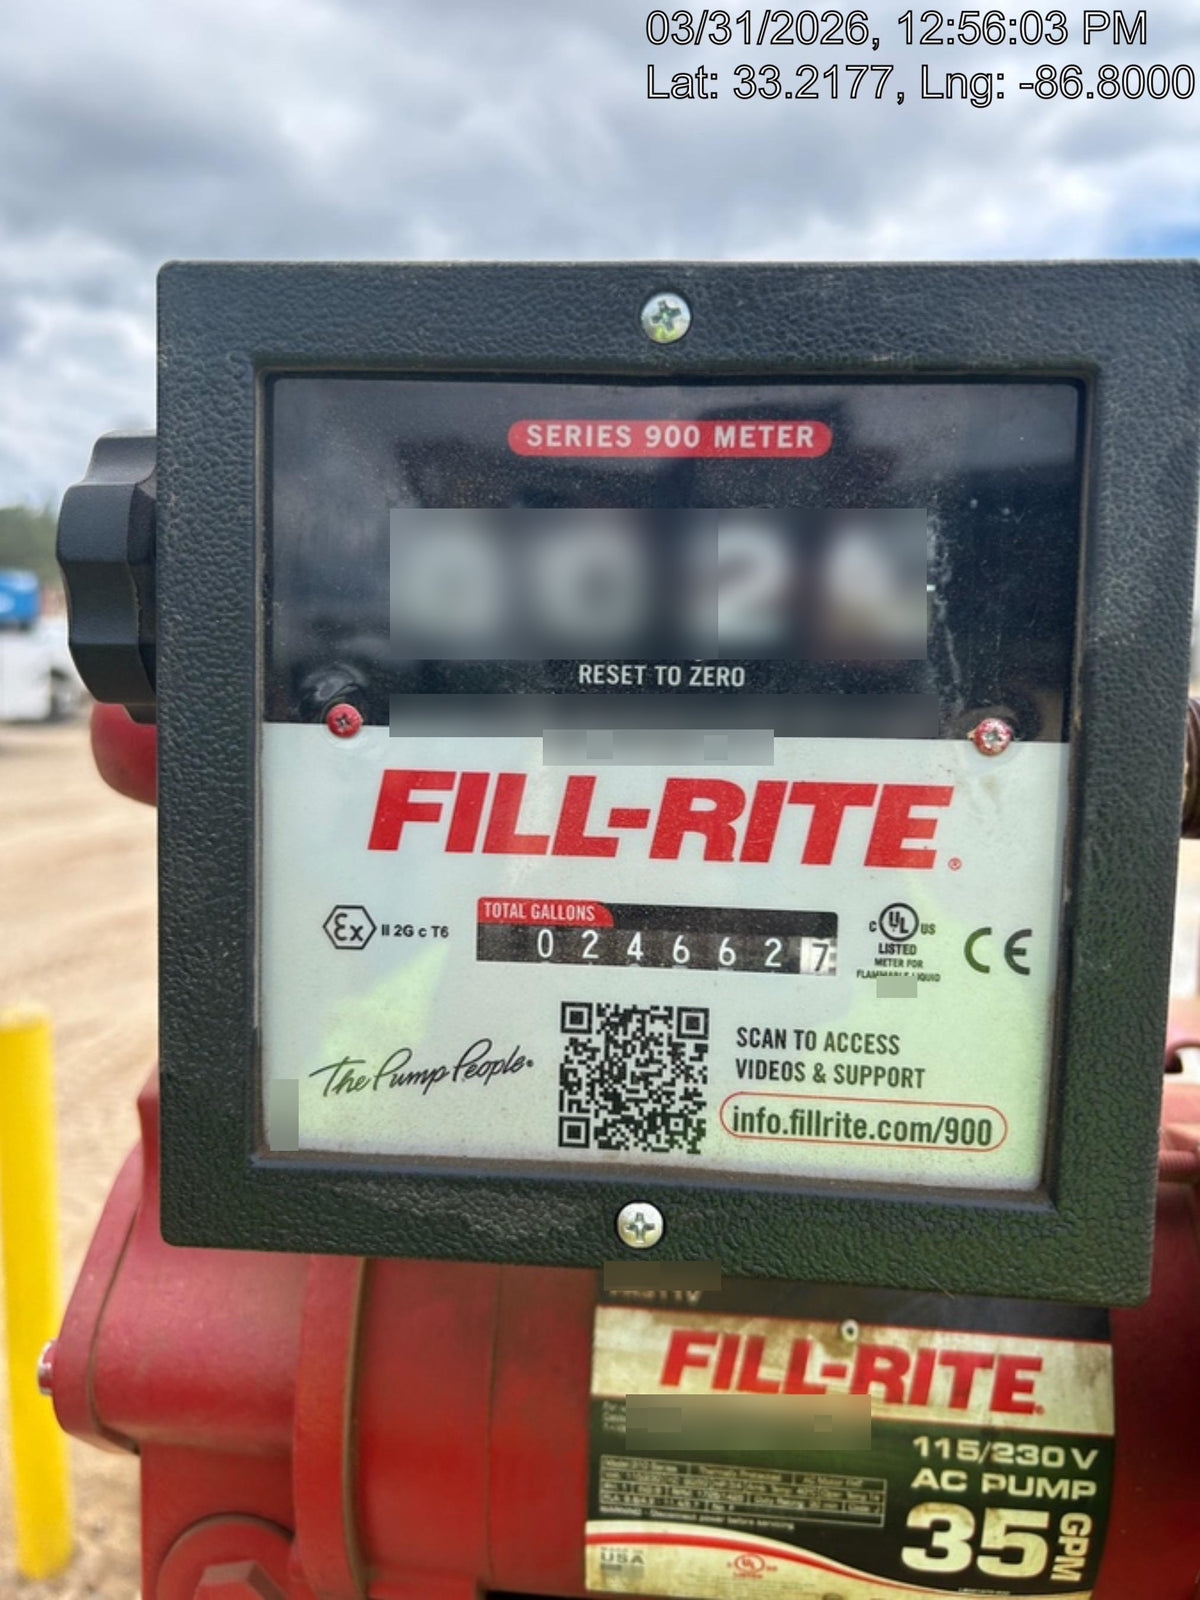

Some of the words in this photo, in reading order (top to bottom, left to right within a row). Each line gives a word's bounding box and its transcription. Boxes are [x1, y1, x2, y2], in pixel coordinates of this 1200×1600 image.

[526, 424, 632, 449] SERIES
[645, 425, 700, 449] 900
[714, 426, 815, 449] METER
[578, 664, 647, 685] RESET
[654, 665, 682, 686] TO
[689, 666, 746, 688] ZERO
[367, 769, 954, 869] FILL-RITE
[484, 901, 526, 920] TOTAL
[531, 902, 595, 923] GALLONS
[888, 911, 909, 934] UL
[393, 924, 415, 938] 2G
[431, 926, 450, 938] T6
[874, 957, 904, 968] METER
[906, 959, 924, 969] FOR
[878, 942, 918, 956] LISTED
[964, 927, 1033, 976] CE
[736, 1027, 788, 1051] SCAN
[793, 1029, 817, 1052] TO
[823, 1031, 901, 1056] ACCESS
[309, 1055, 370, 1097] The
[372, 1047, 450, 1095] Pump
[452, 1038, 526, 1086] People
[735, 1058, 806, 1084] VIDEOS
[812, 1062, 827, 1084] &
[833, 1063, 926, 1090] SUPPORT
[732, 1106, 992, 1147] info.fillrite.com/900
[660, 1329, 1043, 1416] FILL-RITE
[912, 1436, 1066, 1470] 115/230
[1070, 1447, 1099, 1471] V
[910, 1467, 969, 1493] AC
[980, 1472, 1097, 1500] PUMP
[901, 1501, 1051, 1579] 35
[1051, 1512, 1094, 1582] GPM
